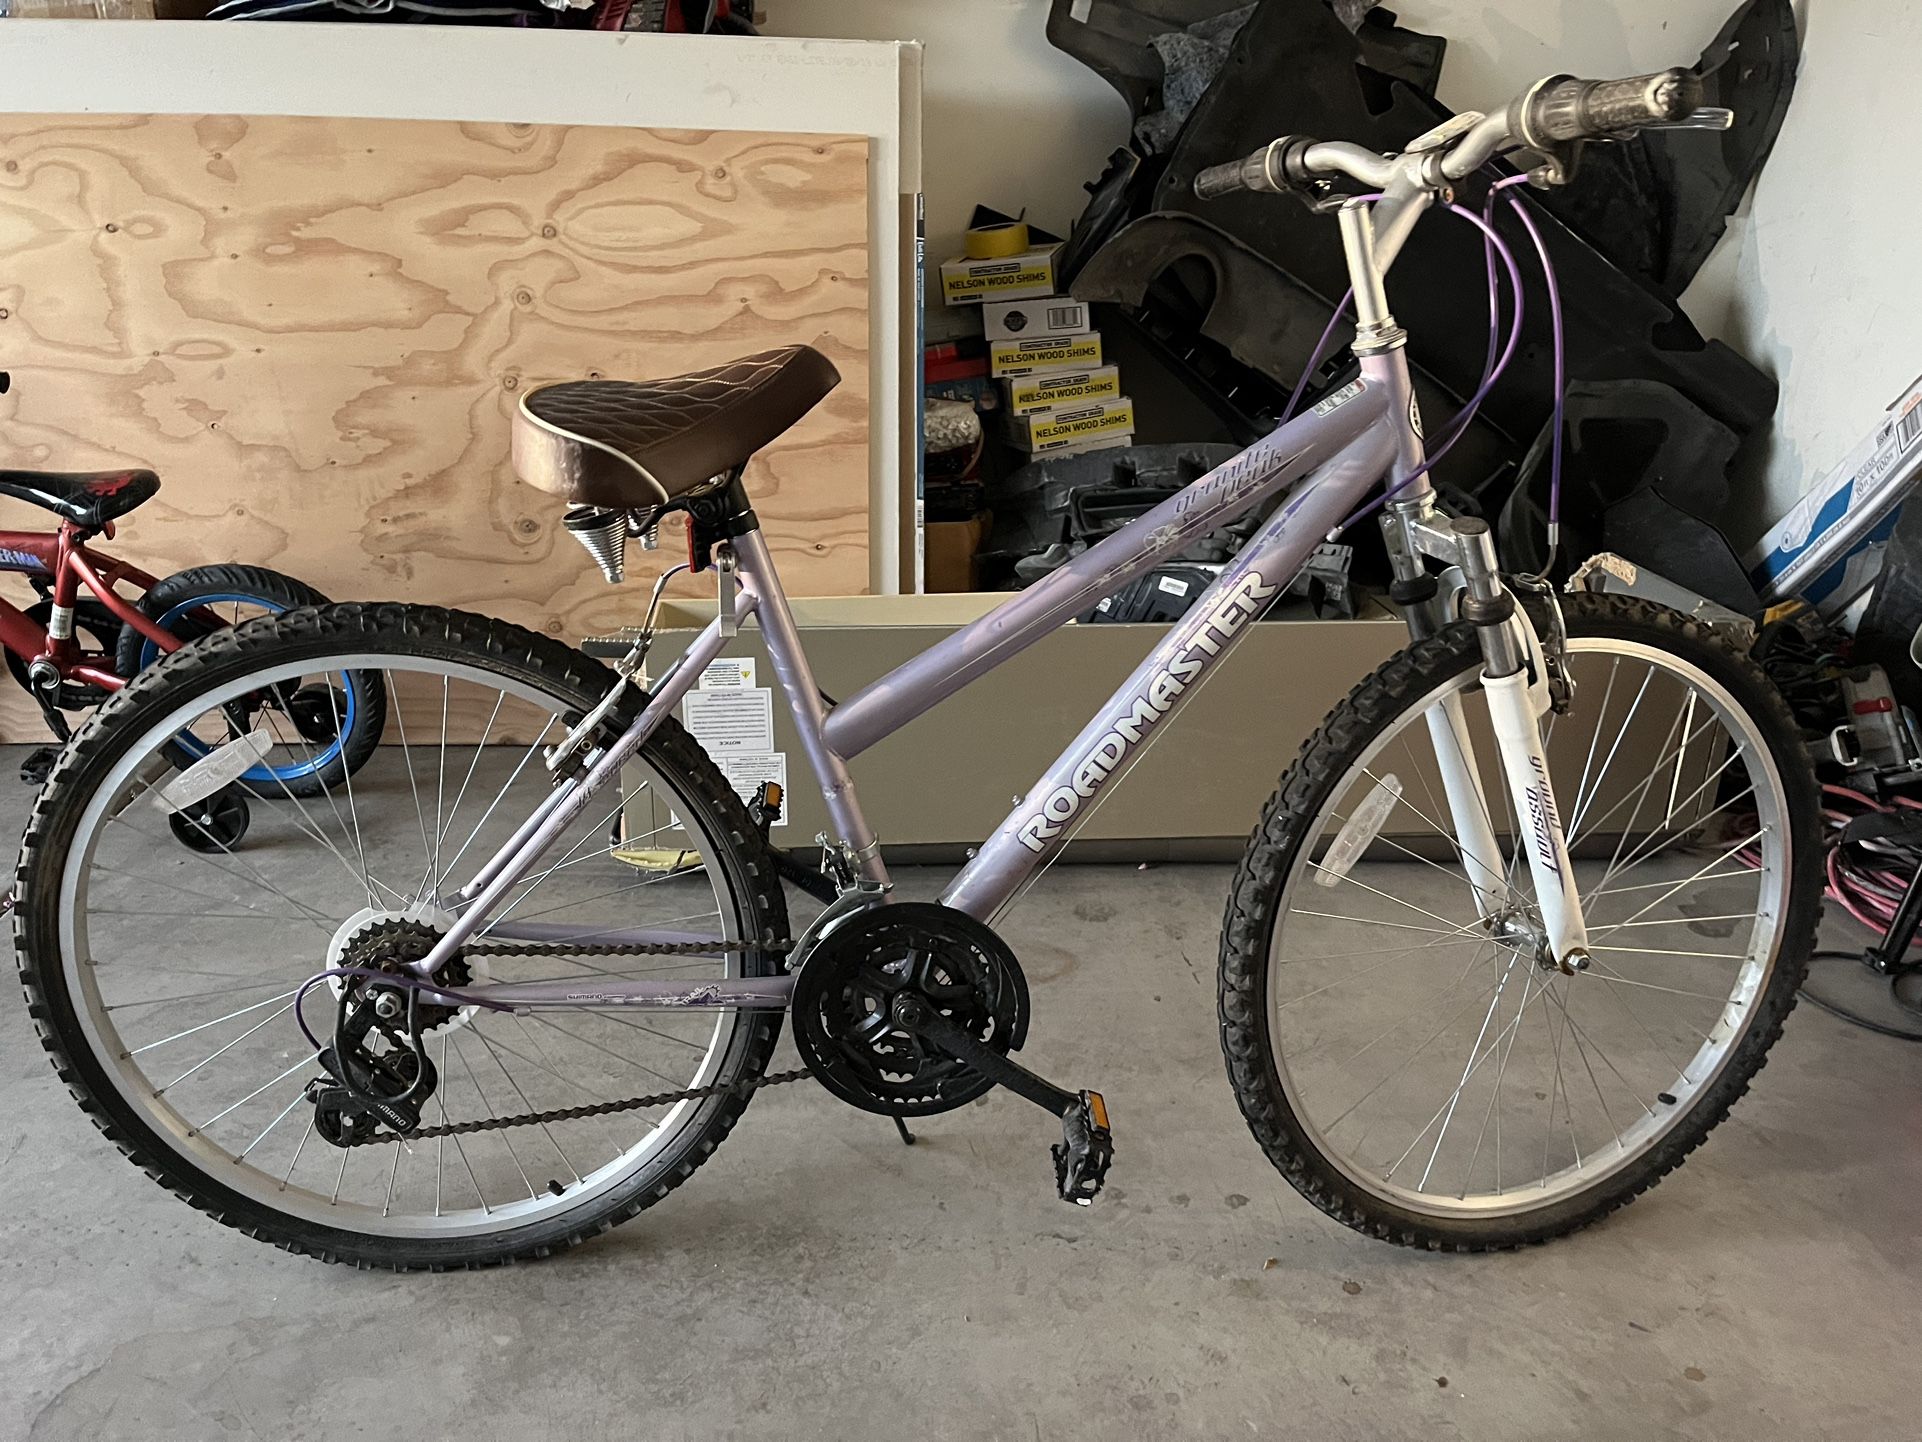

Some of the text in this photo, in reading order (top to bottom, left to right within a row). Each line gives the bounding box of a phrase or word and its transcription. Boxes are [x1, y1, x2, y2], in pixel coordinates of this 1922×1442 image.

[949, 272, 1046, 290] NELSON WOOD SHIMS
[998, 347, 1096, 364] NELSON WOOD SHIMS
[1019, 382, 1113, 403] NELSON WOOD SHIMS
[1036, 414, 1128, 439] NELSON WOOD SHIMS
[1017, 570, 1277, 853] ROADMASTER
[1528, 754, 1562, 830] ground
[1526, 786, 1558, 873] assault
